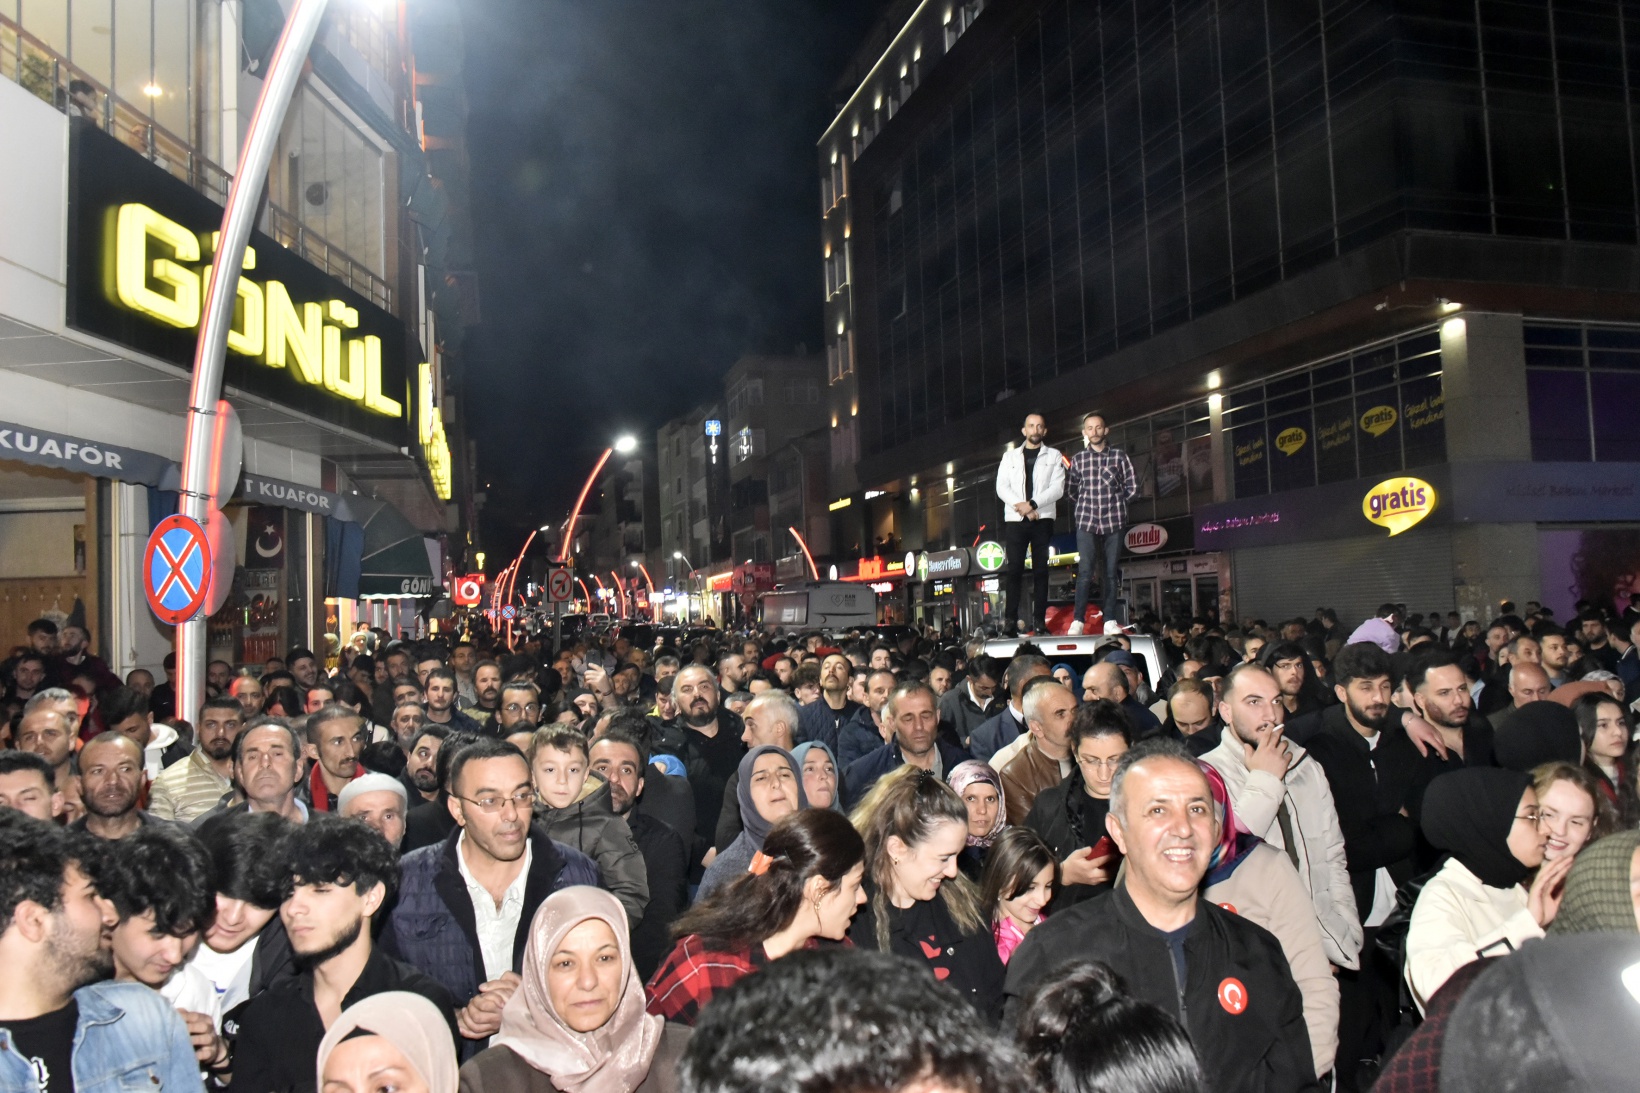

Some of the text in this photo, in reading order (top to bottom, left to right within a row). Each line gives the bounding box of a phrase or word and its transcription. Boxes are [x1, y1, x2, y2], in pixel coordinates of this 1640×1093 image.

[116, 202, 403, 418] GÖNÜL
[1363, 407, 1393, 429] gratis
[0, 429, 122, 470] KUAFÖR
[1278, 429, 1303, 449] gratis
[1369, 482, 1426, 519] gratis
[1128, 525, 1160, 548] mendy
